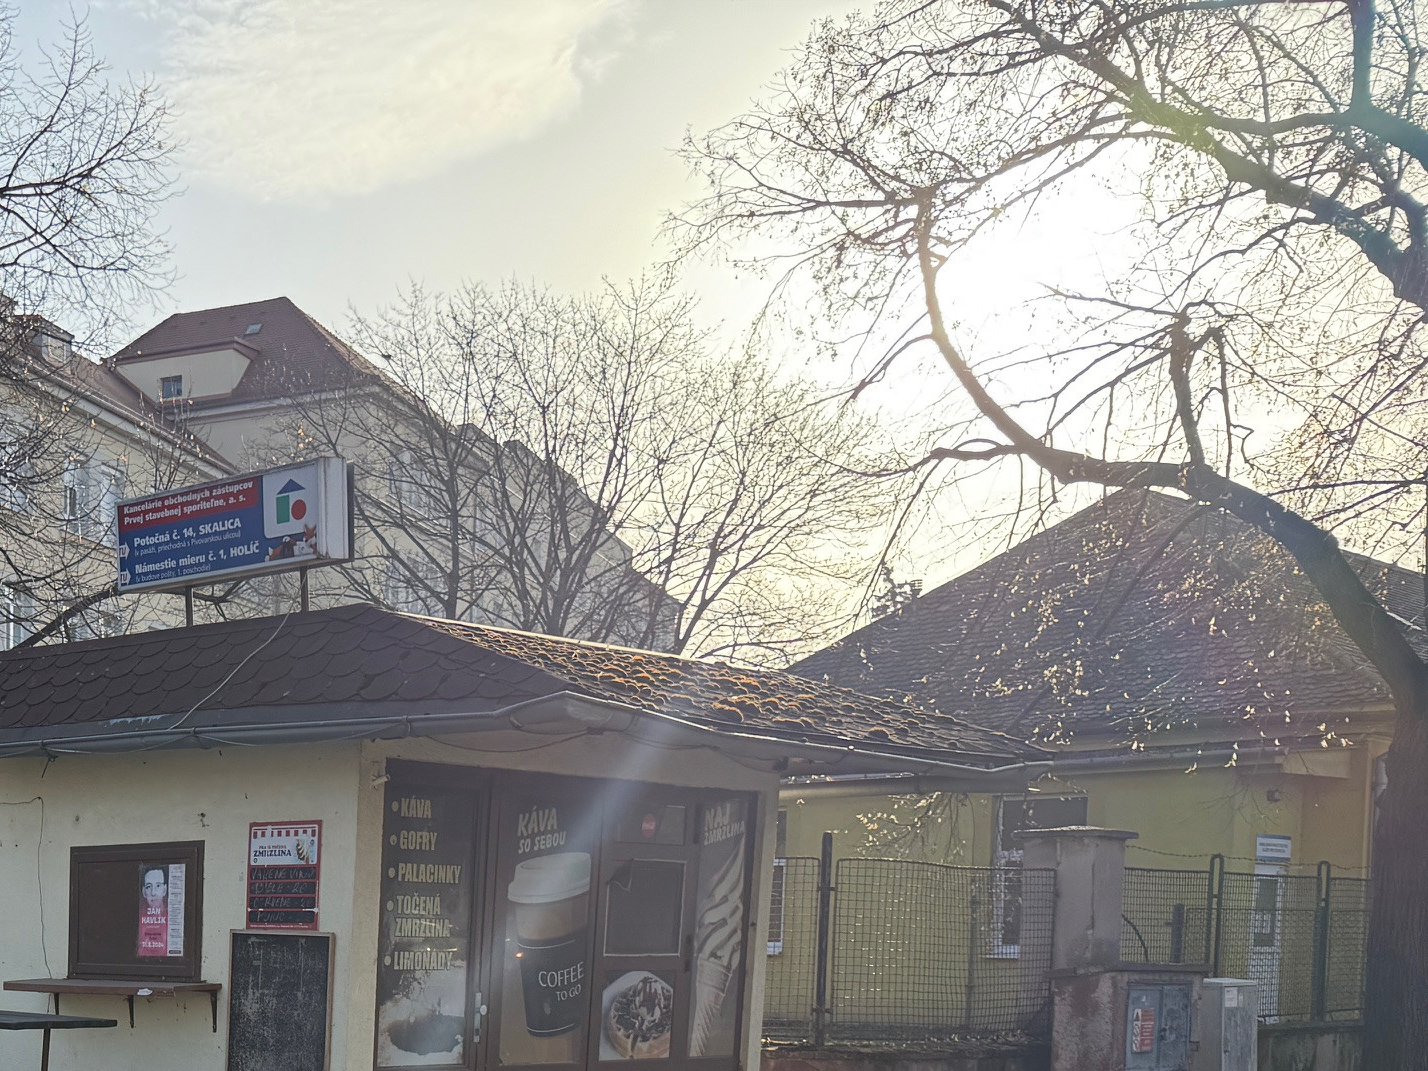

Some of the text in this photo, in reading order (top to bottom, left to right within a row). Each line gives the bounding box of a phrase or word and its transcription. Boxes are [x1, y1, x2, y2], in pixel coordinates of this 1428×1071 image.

[124, 481, 253, 514] Kancelárie obchodných zástupcov
[124, 513, 143, 525] Prvej
[145, 506, 181, 521] stavebnej
[183, 499, 226, 514] sporiteľne,
[134, 518, 241, 547] Potočná č. 14, SKALICA
[135, 540, 259, 574] Námestie mieru č. 1, HOLÍČ
[400, 795, 432, 818] KÁVA
[705, 803, 731, 831] NAJ
[518, 805, 557, 836] KÁVA
[400, 830, 437, 851] GOFRY
[518, 831, 566, 854] SO SEBOU
[704, 821, 745, 845] ZMRZLINA
[398, 862, 461, 884] PALACINKY
[396, 892, 441, 915] TOČENÁ
[395, 917, 451, 937] ZMRZLINA
[539, 961, 584, 987] COFFEE
[556, 984, 581, 1001] TO GO
